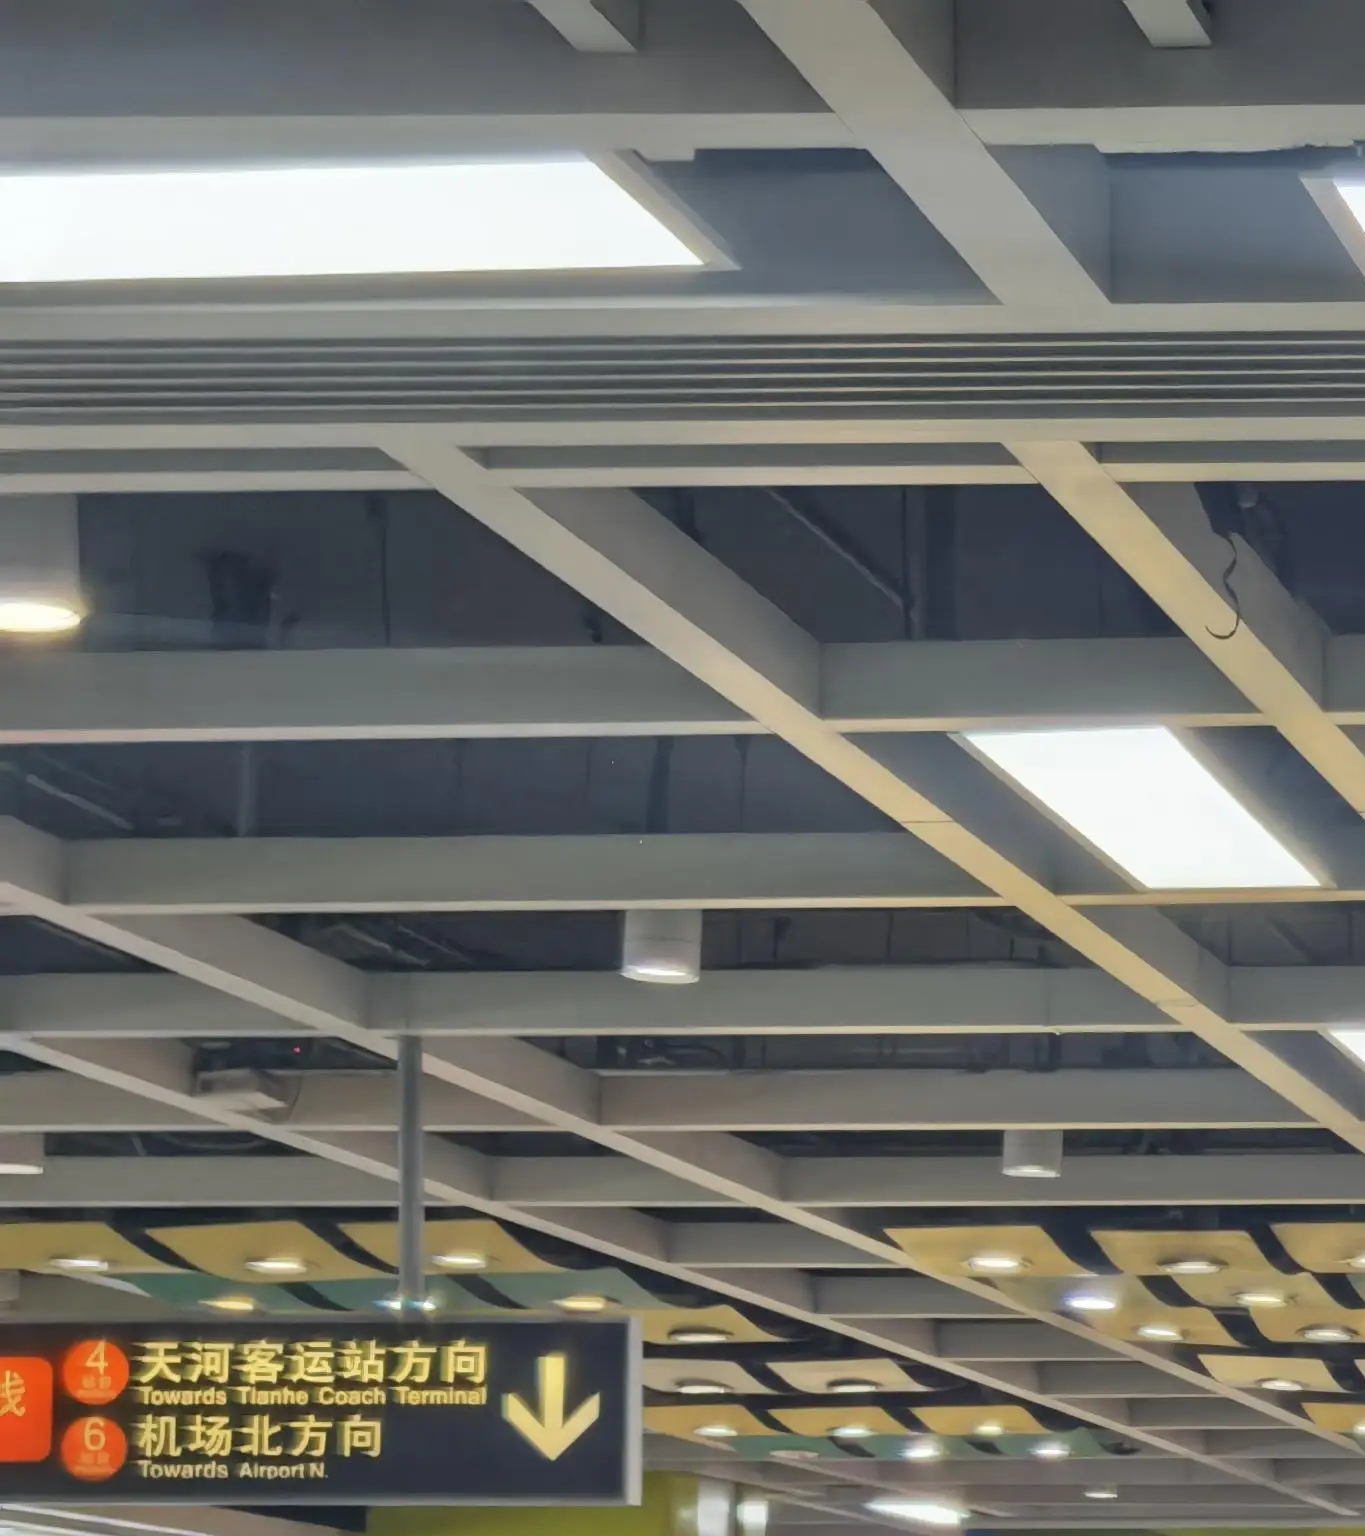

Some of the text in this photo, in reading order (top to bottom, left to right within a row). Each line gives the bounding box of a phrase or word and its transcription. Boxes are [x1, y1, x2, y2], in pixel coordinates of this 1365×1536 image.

[85, 1338, 109, 1376] 4
[138, 1340, 488, 1384] 天河客运站方向
[141, 1386, 487, 1405] Towards Tianhe Coach Terminal
[84, 1416, 107, 1452] 6
[139, 1413, 382, 1458] 机场北方向
[140, 1461, 328, 1480] Towards Airport N.
